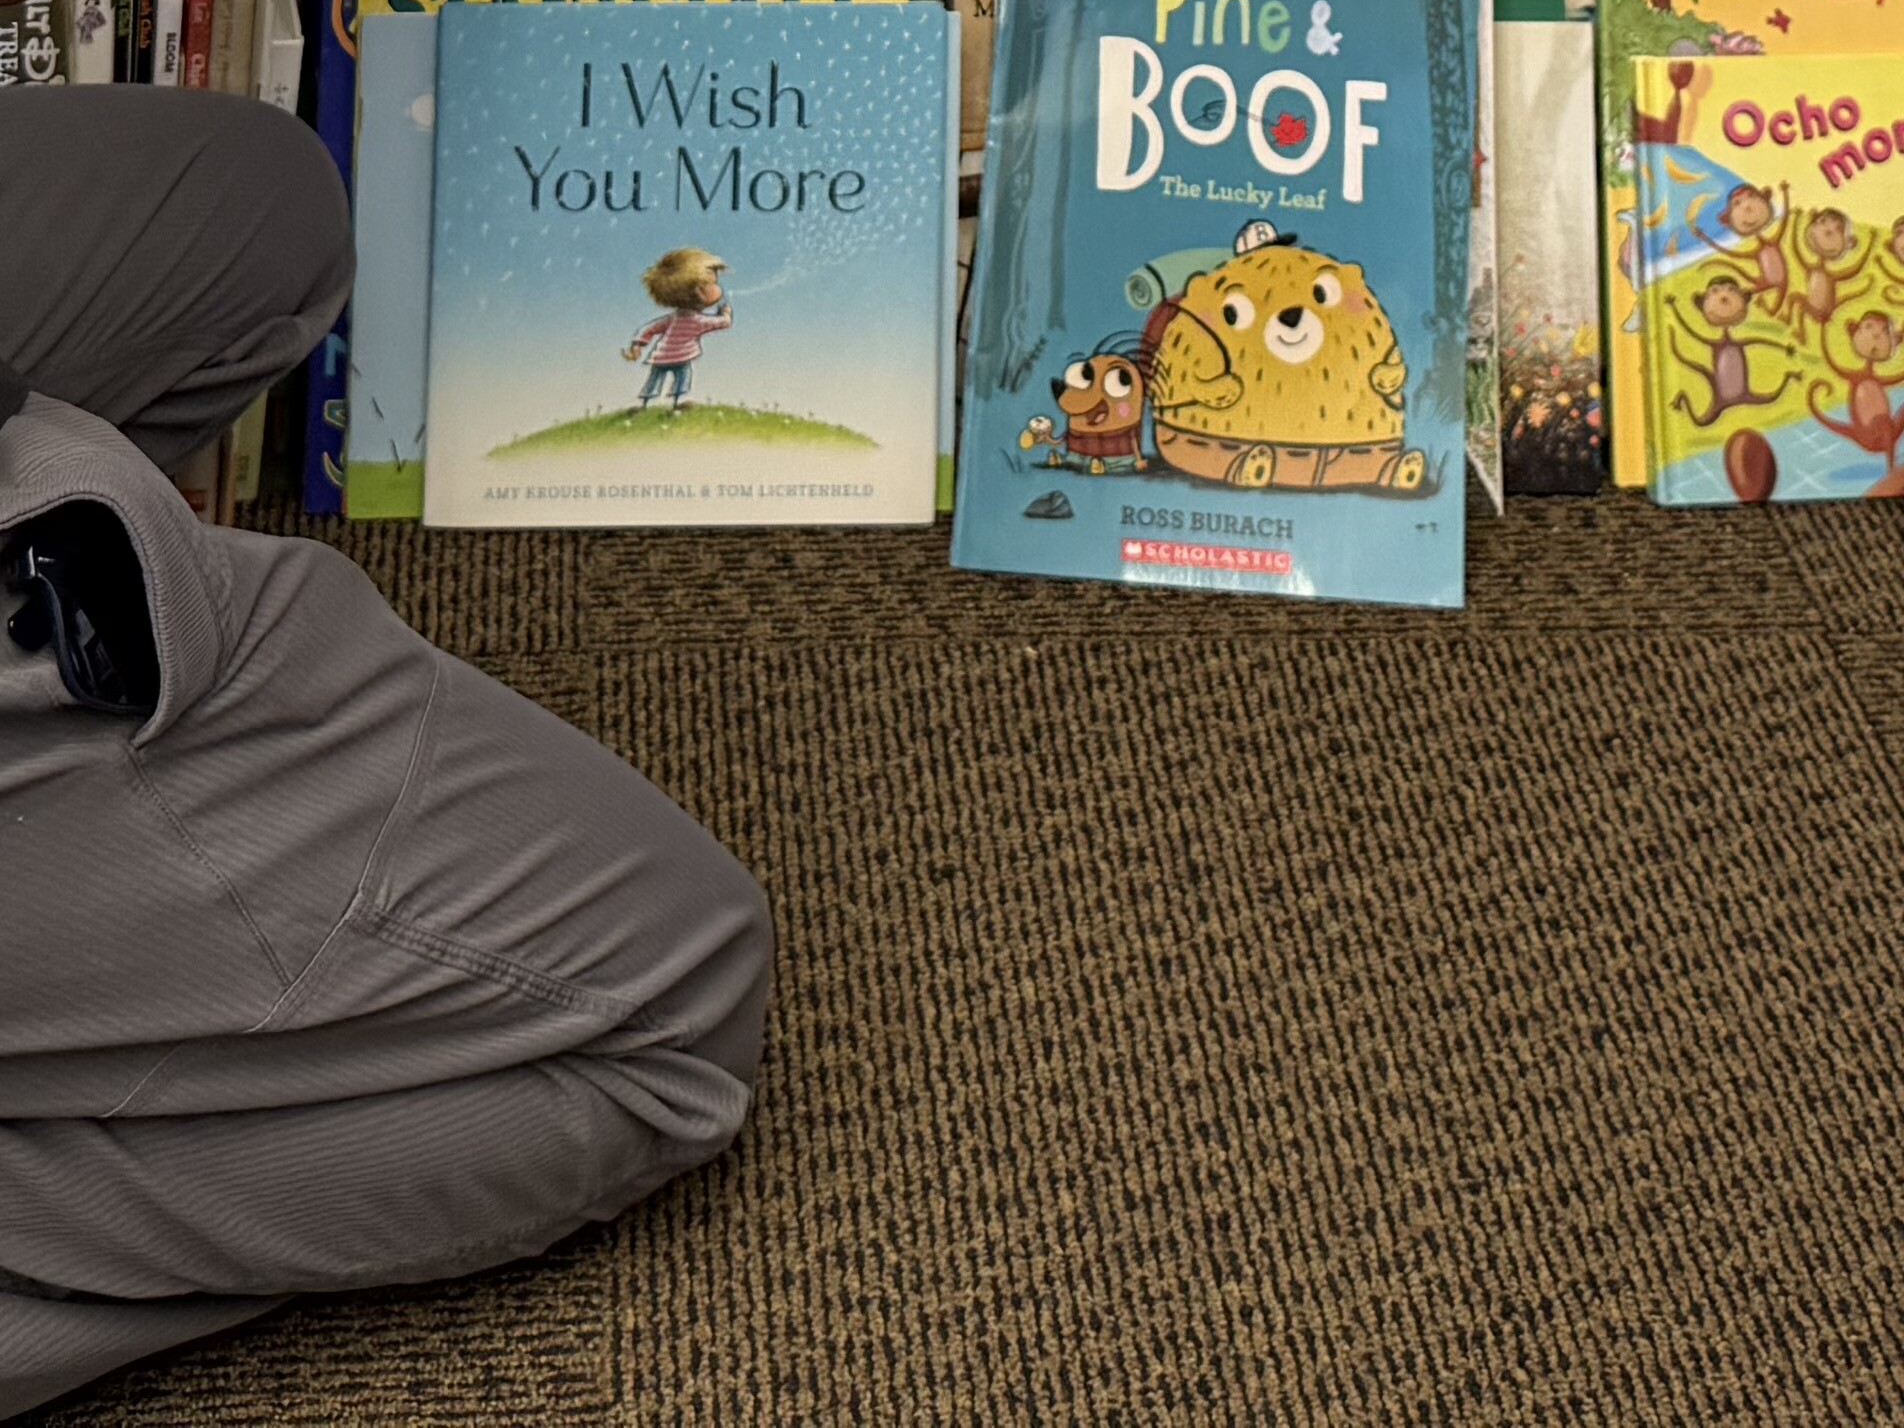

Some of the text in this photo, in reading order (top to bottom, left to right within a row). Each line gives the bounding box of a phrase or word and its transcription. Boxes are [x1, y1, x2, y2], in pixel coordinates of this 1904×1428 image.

[1305, 0, 1343, 56] &
[580, 59, 812, 129] I Wish
[1097, 35, 1388, 204] BOOF
[1722, 93, 1861, 147] Ocho
[514, 145, 865, 212] You More
[1160, 175, 1327, 210] The Lucky Leaf
[1120, 505, 1294, 539] ROSS BURACH
[1146, 544, 1288, 569] SCHOLASTIC
